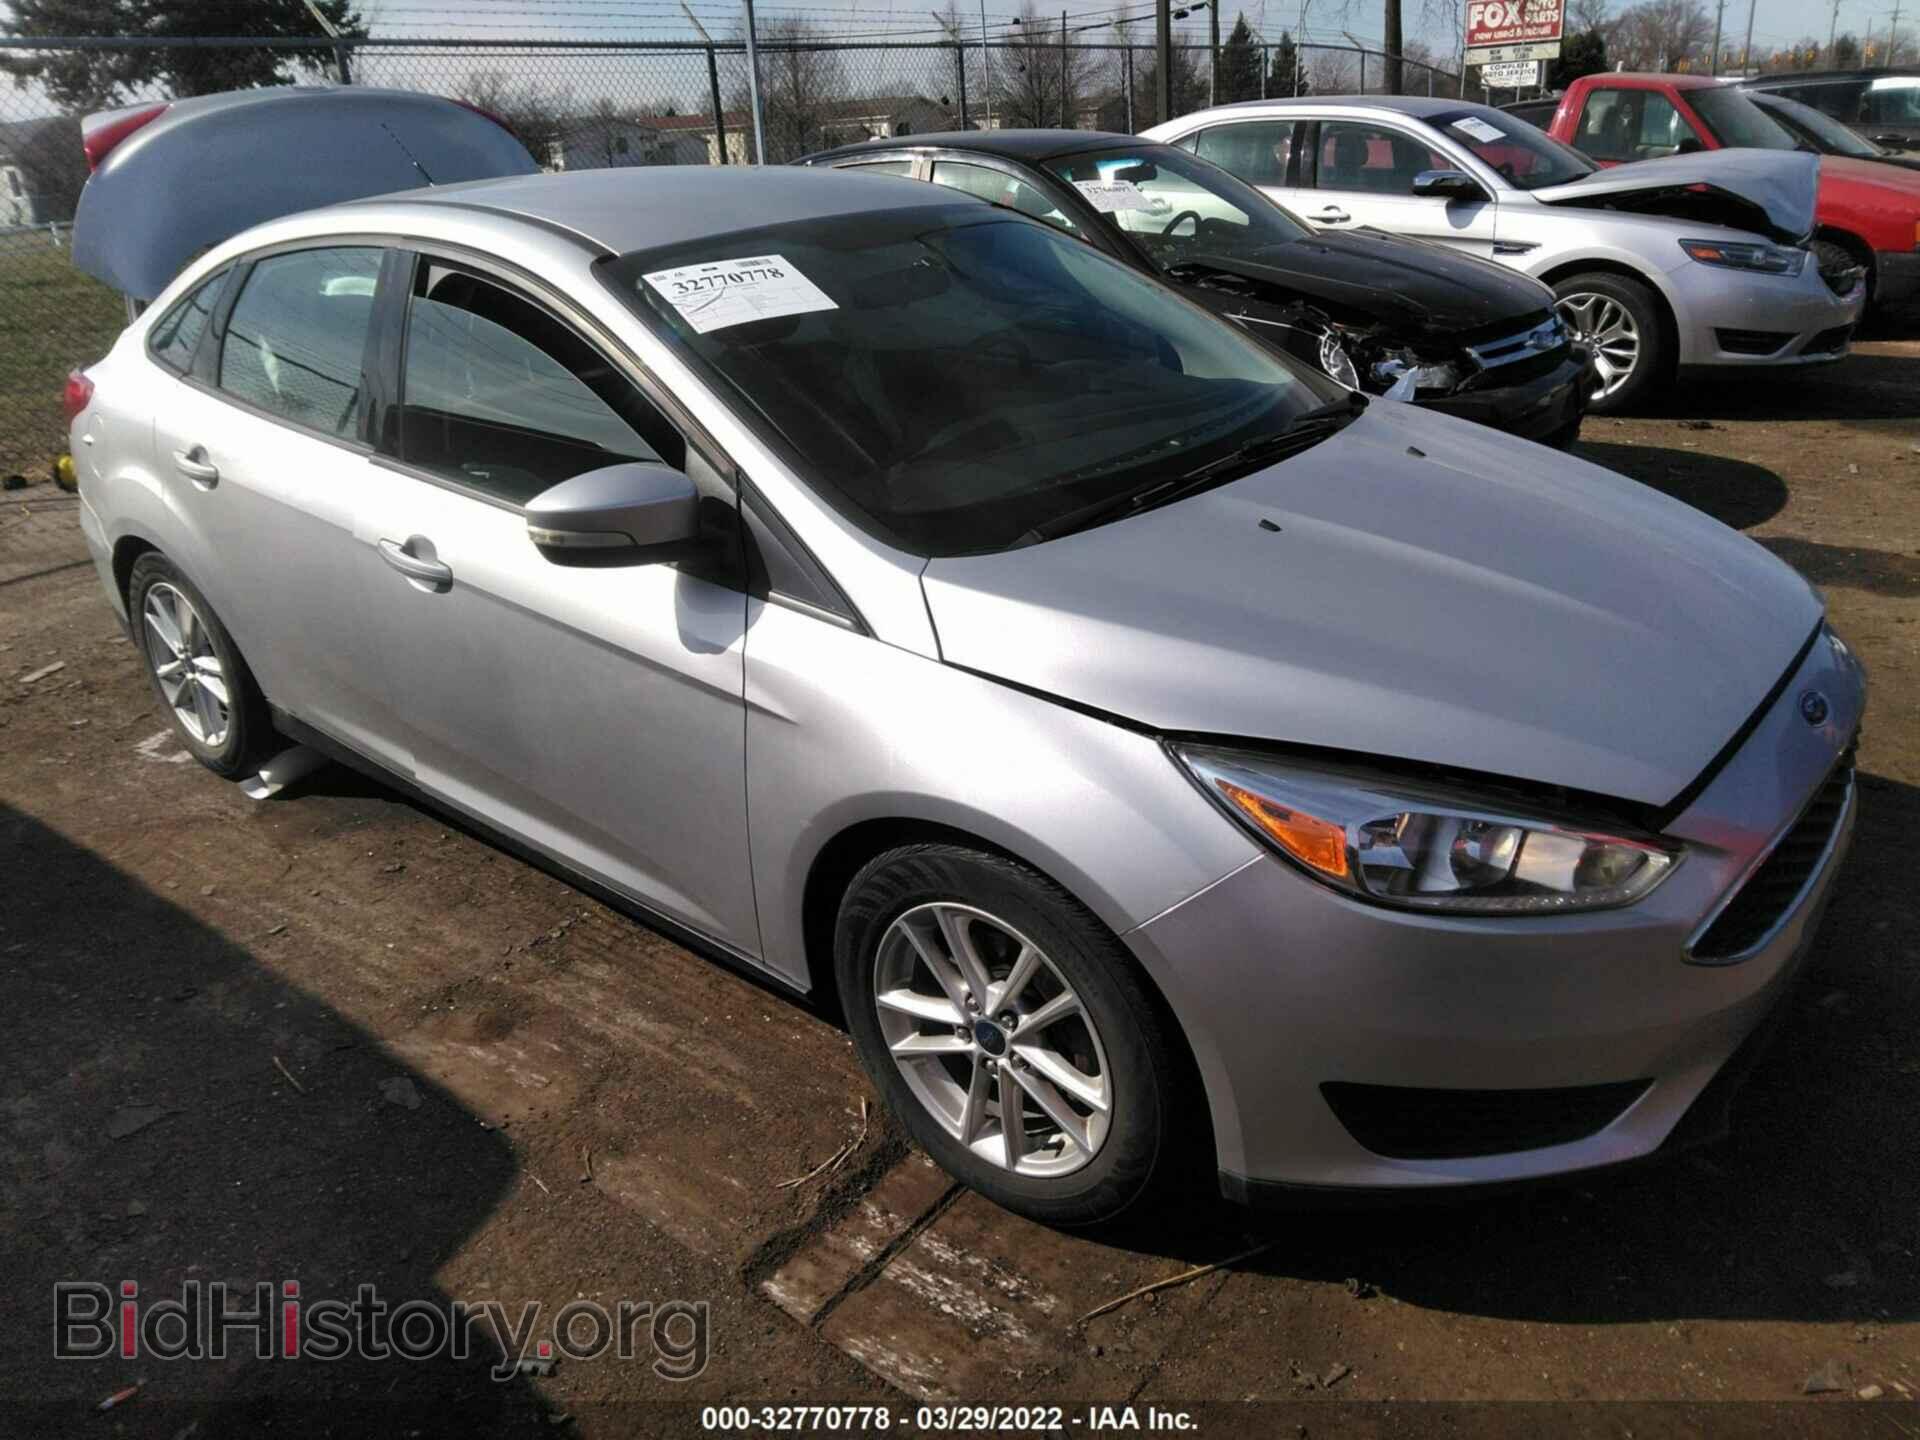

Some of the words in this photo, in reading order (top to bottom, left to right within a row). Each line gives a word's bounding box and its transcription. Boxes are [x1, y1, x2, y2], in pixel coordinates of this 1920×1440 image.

[1526, 0, 1557, 10] AUTO
[1469, 1, 1522, 29] FOX
[1524, 10, 1559, 24] PARTS
[1493, 28, 1515, 39] used
[1489, 62, 1530, 71] COMPLETE
[672, 267, 785, 294] 32770778
